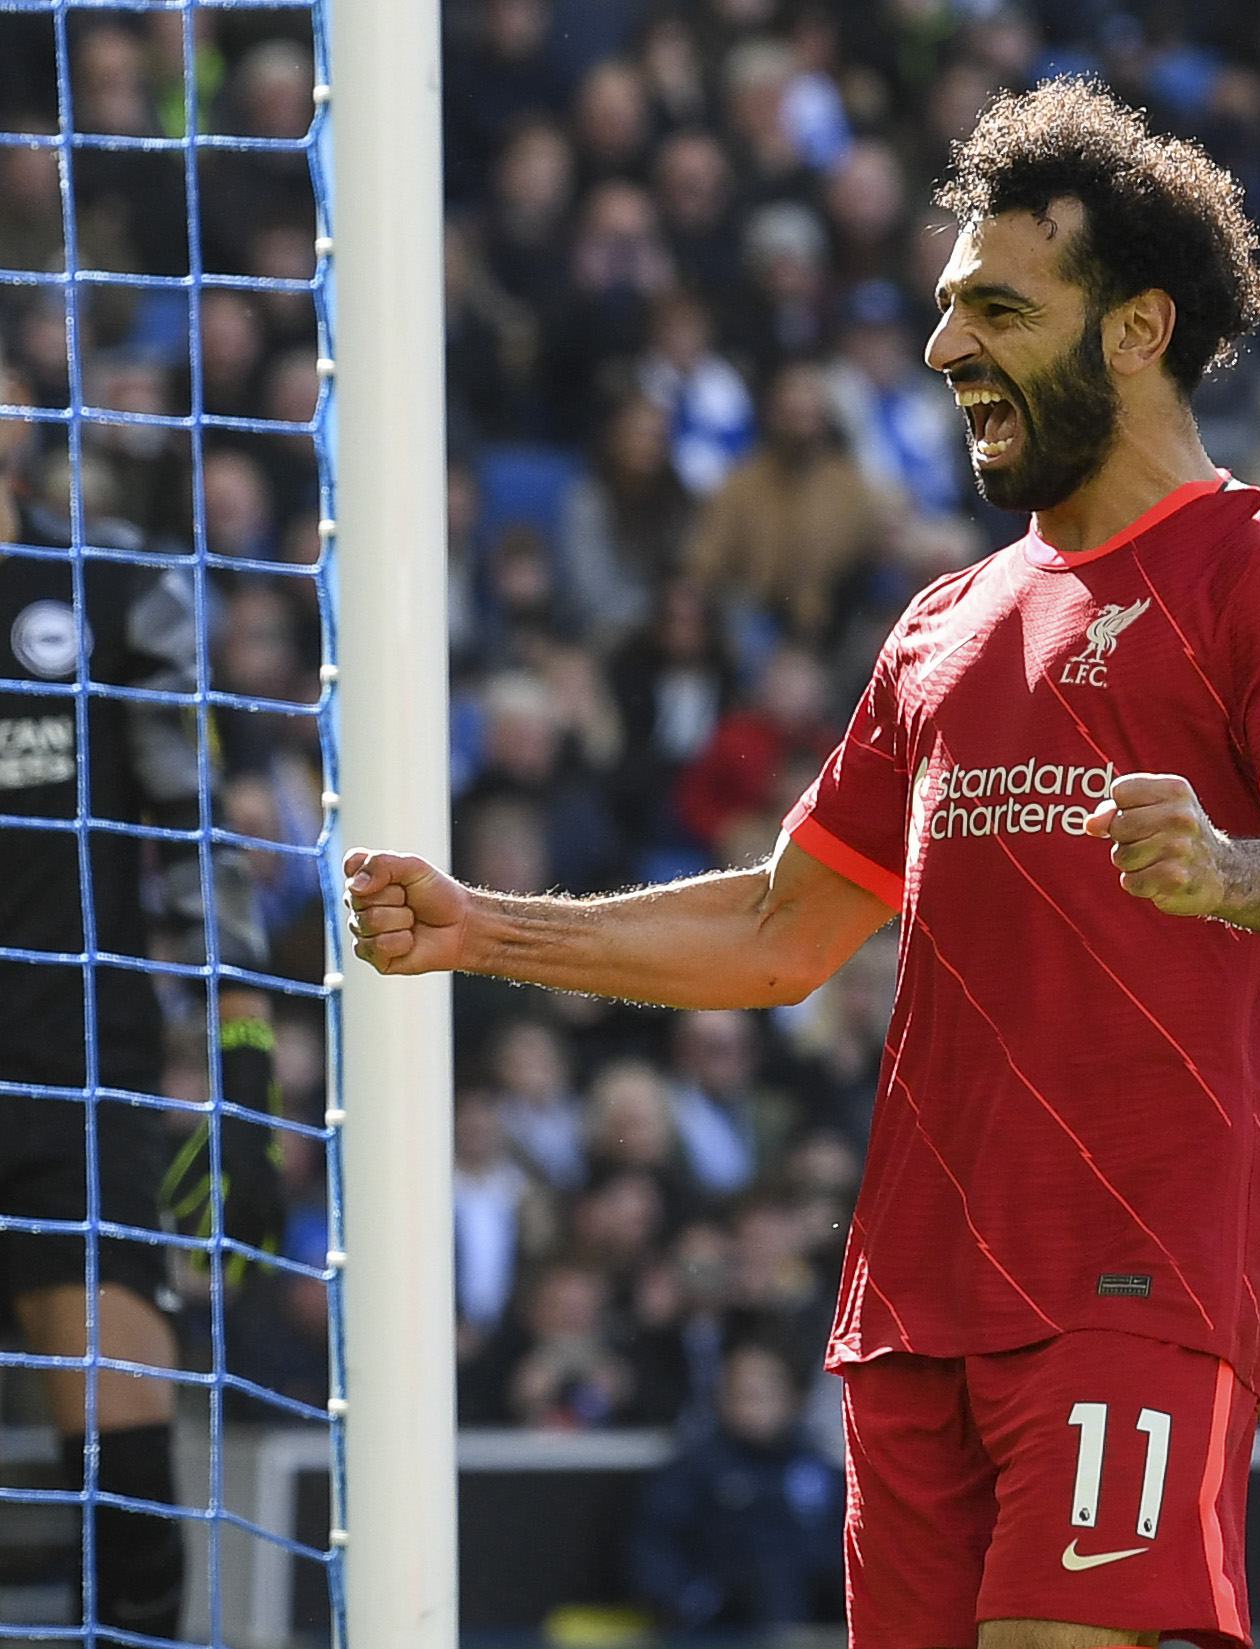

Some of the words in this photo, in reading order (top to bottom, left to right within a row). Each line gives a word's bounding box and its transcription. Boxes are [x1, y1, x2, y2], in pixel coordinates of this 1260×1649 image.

[938, 757, 1114, 801] standard
[931, 796, 1089, 840] chartere
[1067, 1402, 1171, 1540] 11
